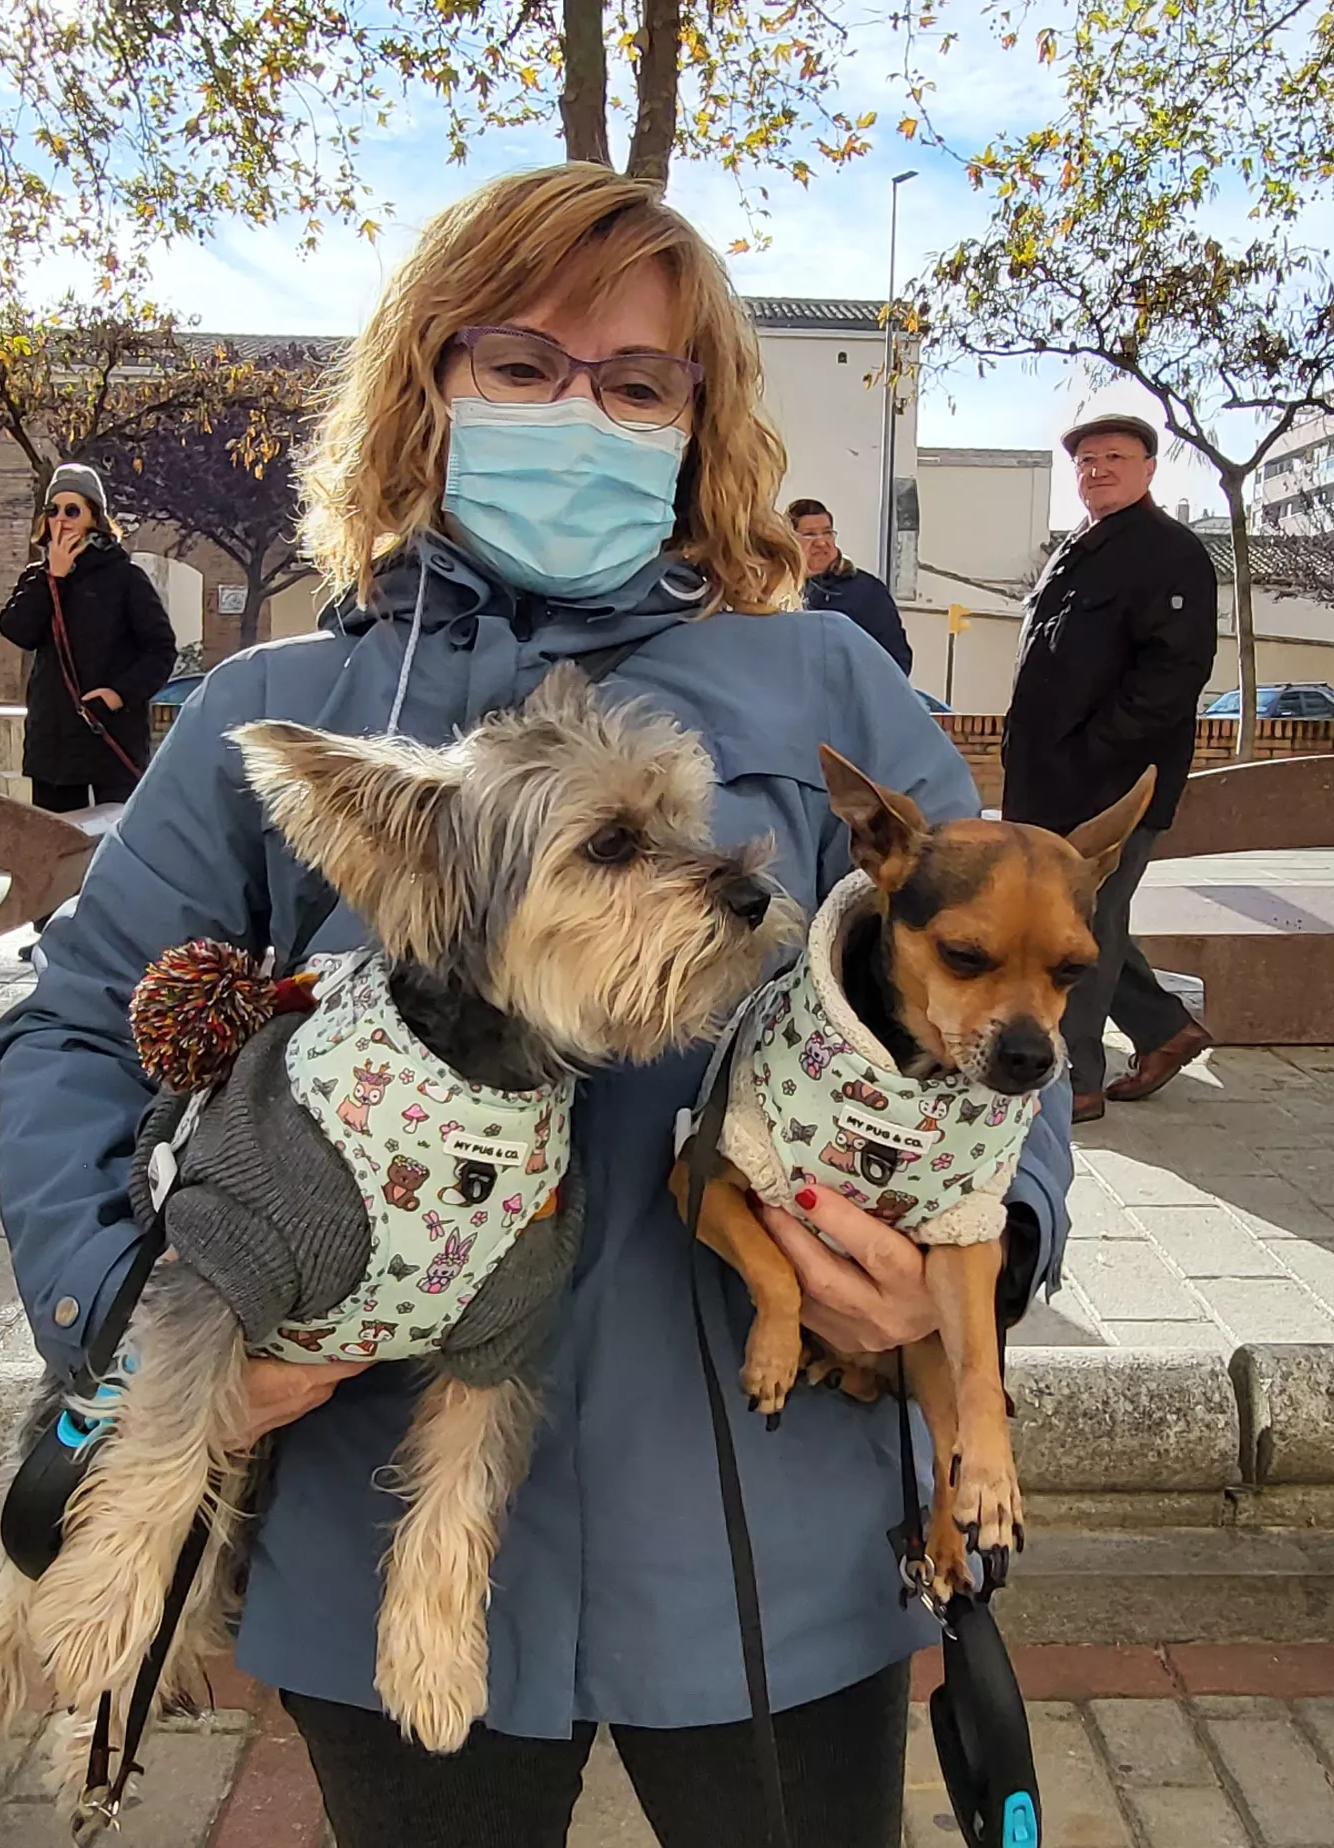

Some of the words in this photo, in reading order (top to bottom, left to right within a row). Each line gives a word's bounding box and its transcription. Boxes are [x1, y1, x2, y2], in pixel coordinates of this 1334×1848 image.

[847, 1116, 864, 1128] MY
[866, 1124, 890, 1139] PUG
[892, 1133, 902, 1143] &
[453, 1140, 471, 1151] MY
[471, 1144, 494, 1156] PUG
